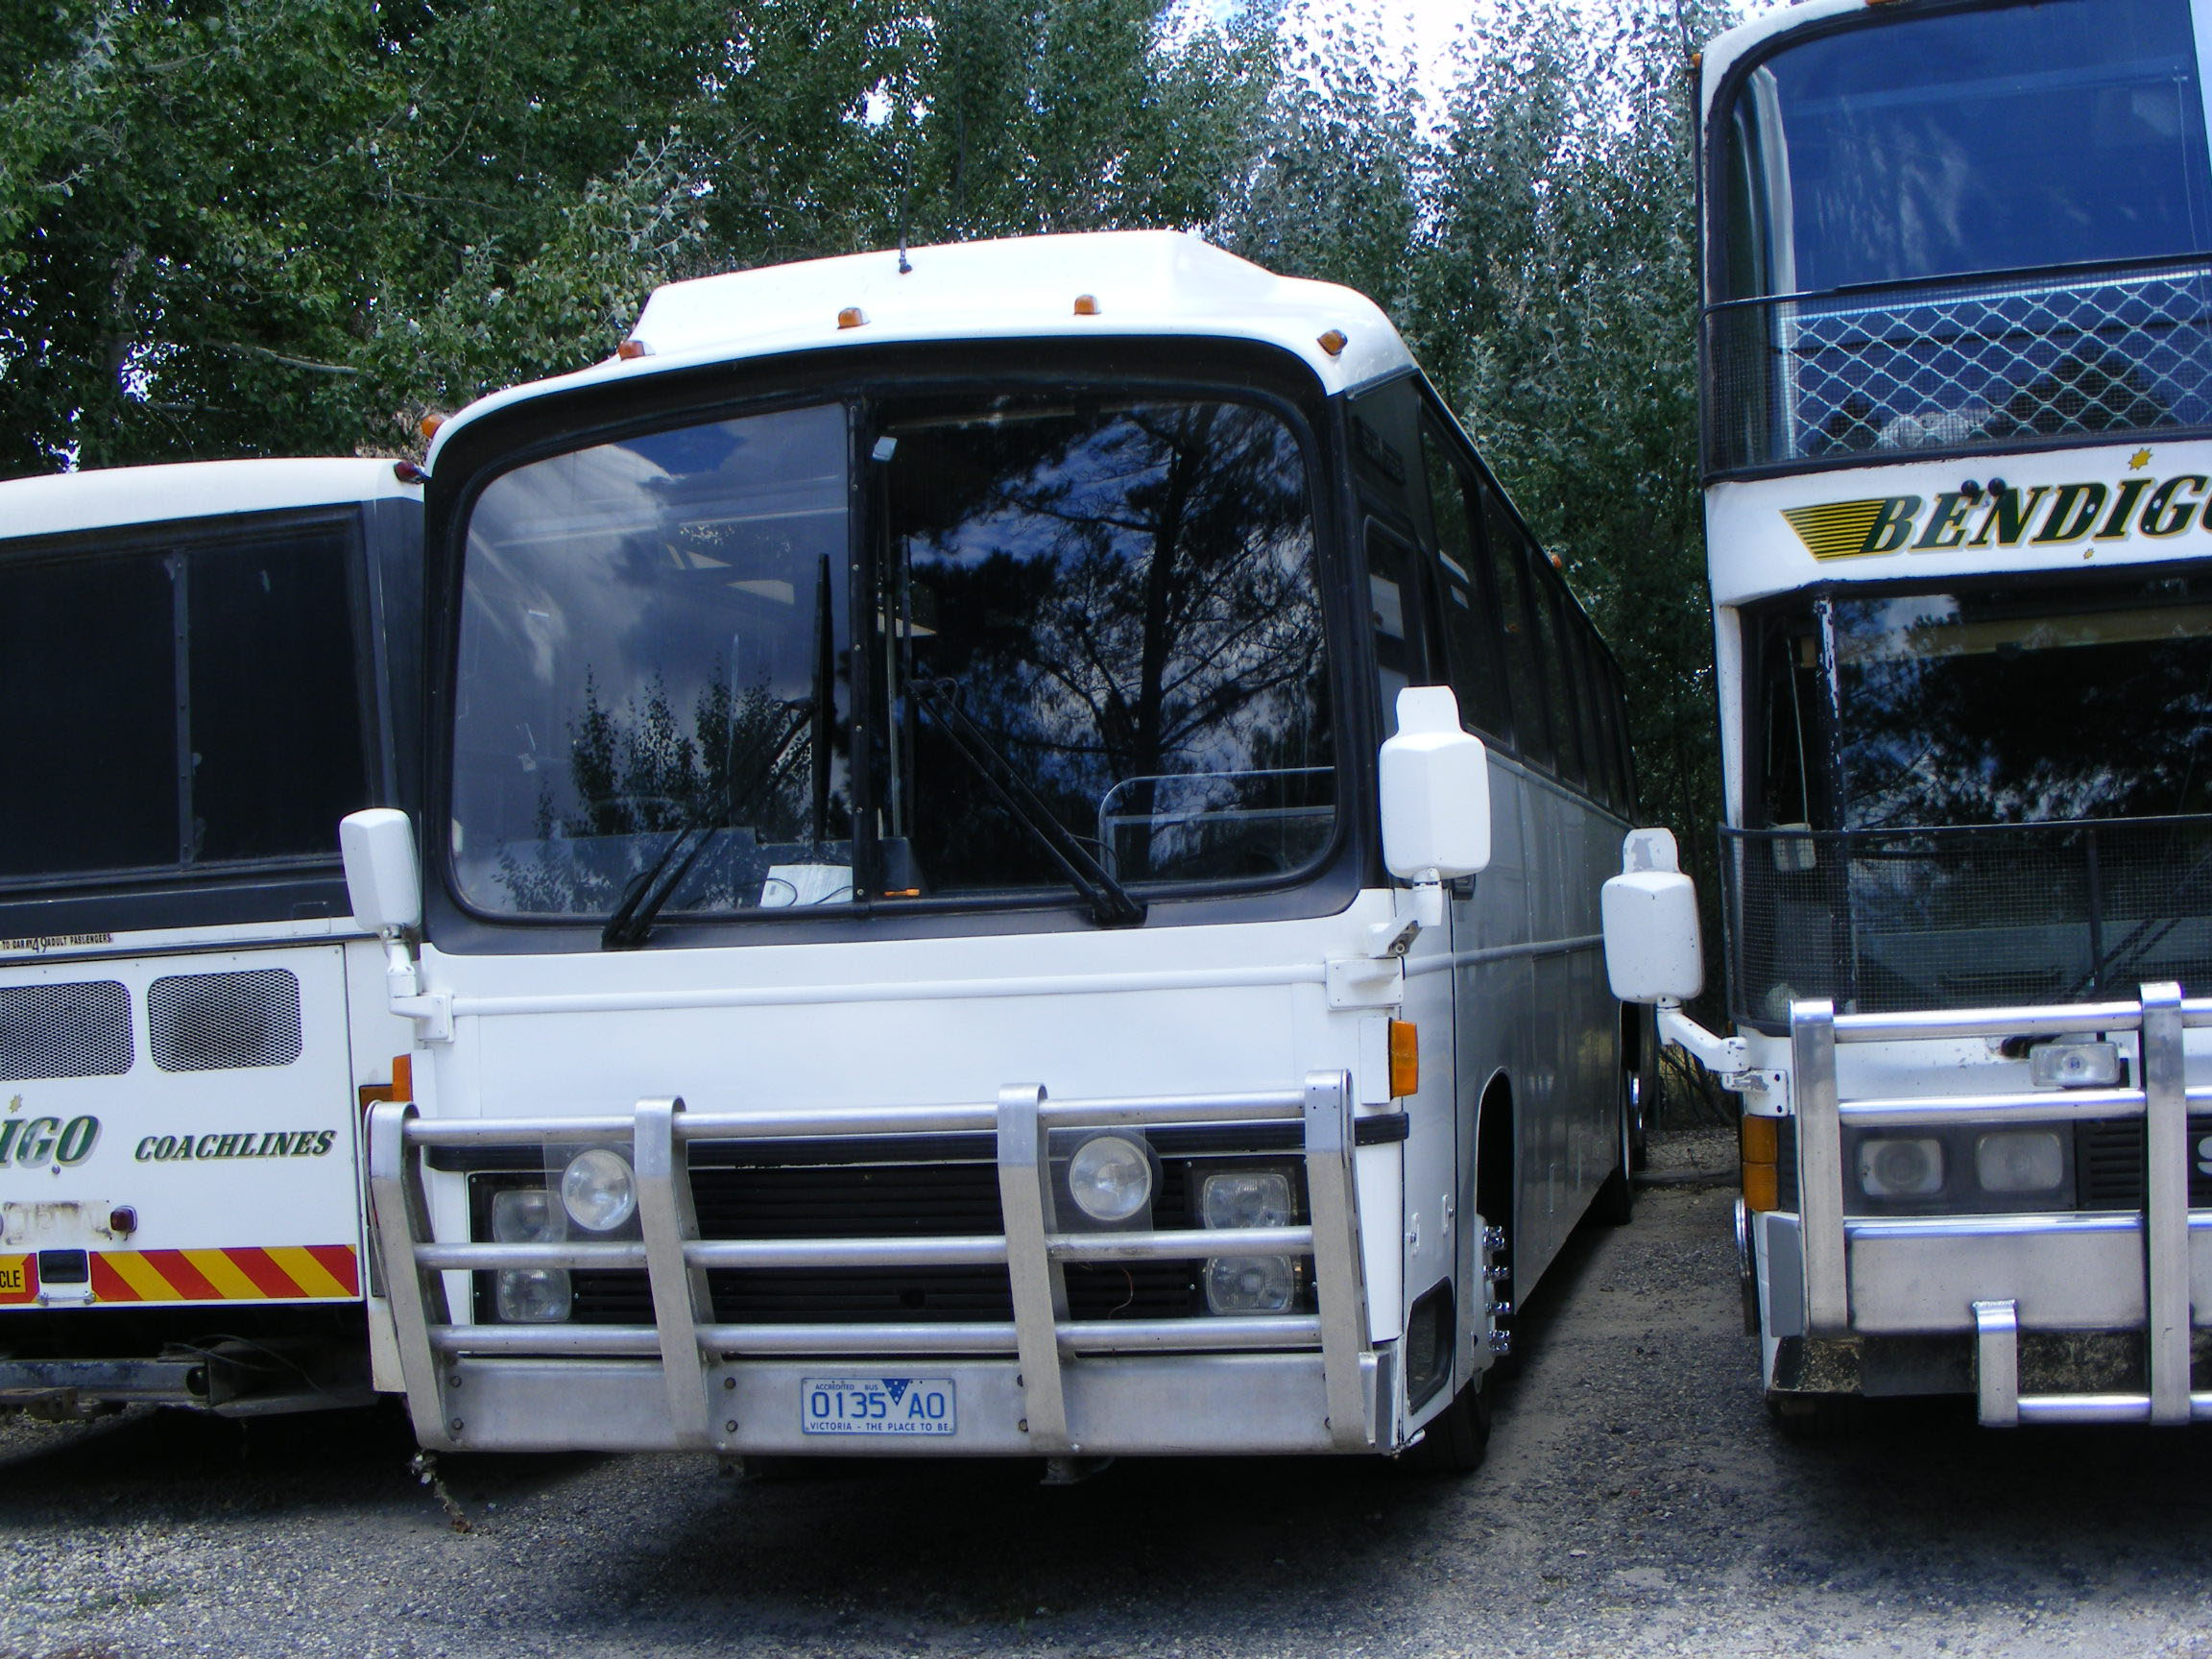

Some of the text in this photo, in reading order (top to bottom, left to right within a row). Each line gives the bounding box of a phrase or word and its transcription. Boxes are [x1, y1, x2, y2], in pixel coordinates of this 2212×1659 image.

[1859, 473, 2212, 556] BENDIG
[32, 936, 47, 953] 49
[46, 936, 67, 947] ADULT
[70, 932, 112, 945] PASSENGERS
[134, 1129, 337, 1163] COACHLINES
[811, 1391, 887, 1419] 0135
[809, 1422, 853, 1431] VICTORIA
[866, 1422, 882, 1431] THE
[887, 1422, 916, 1431] PLACE
[920, 1422, 933, 1431] TO
